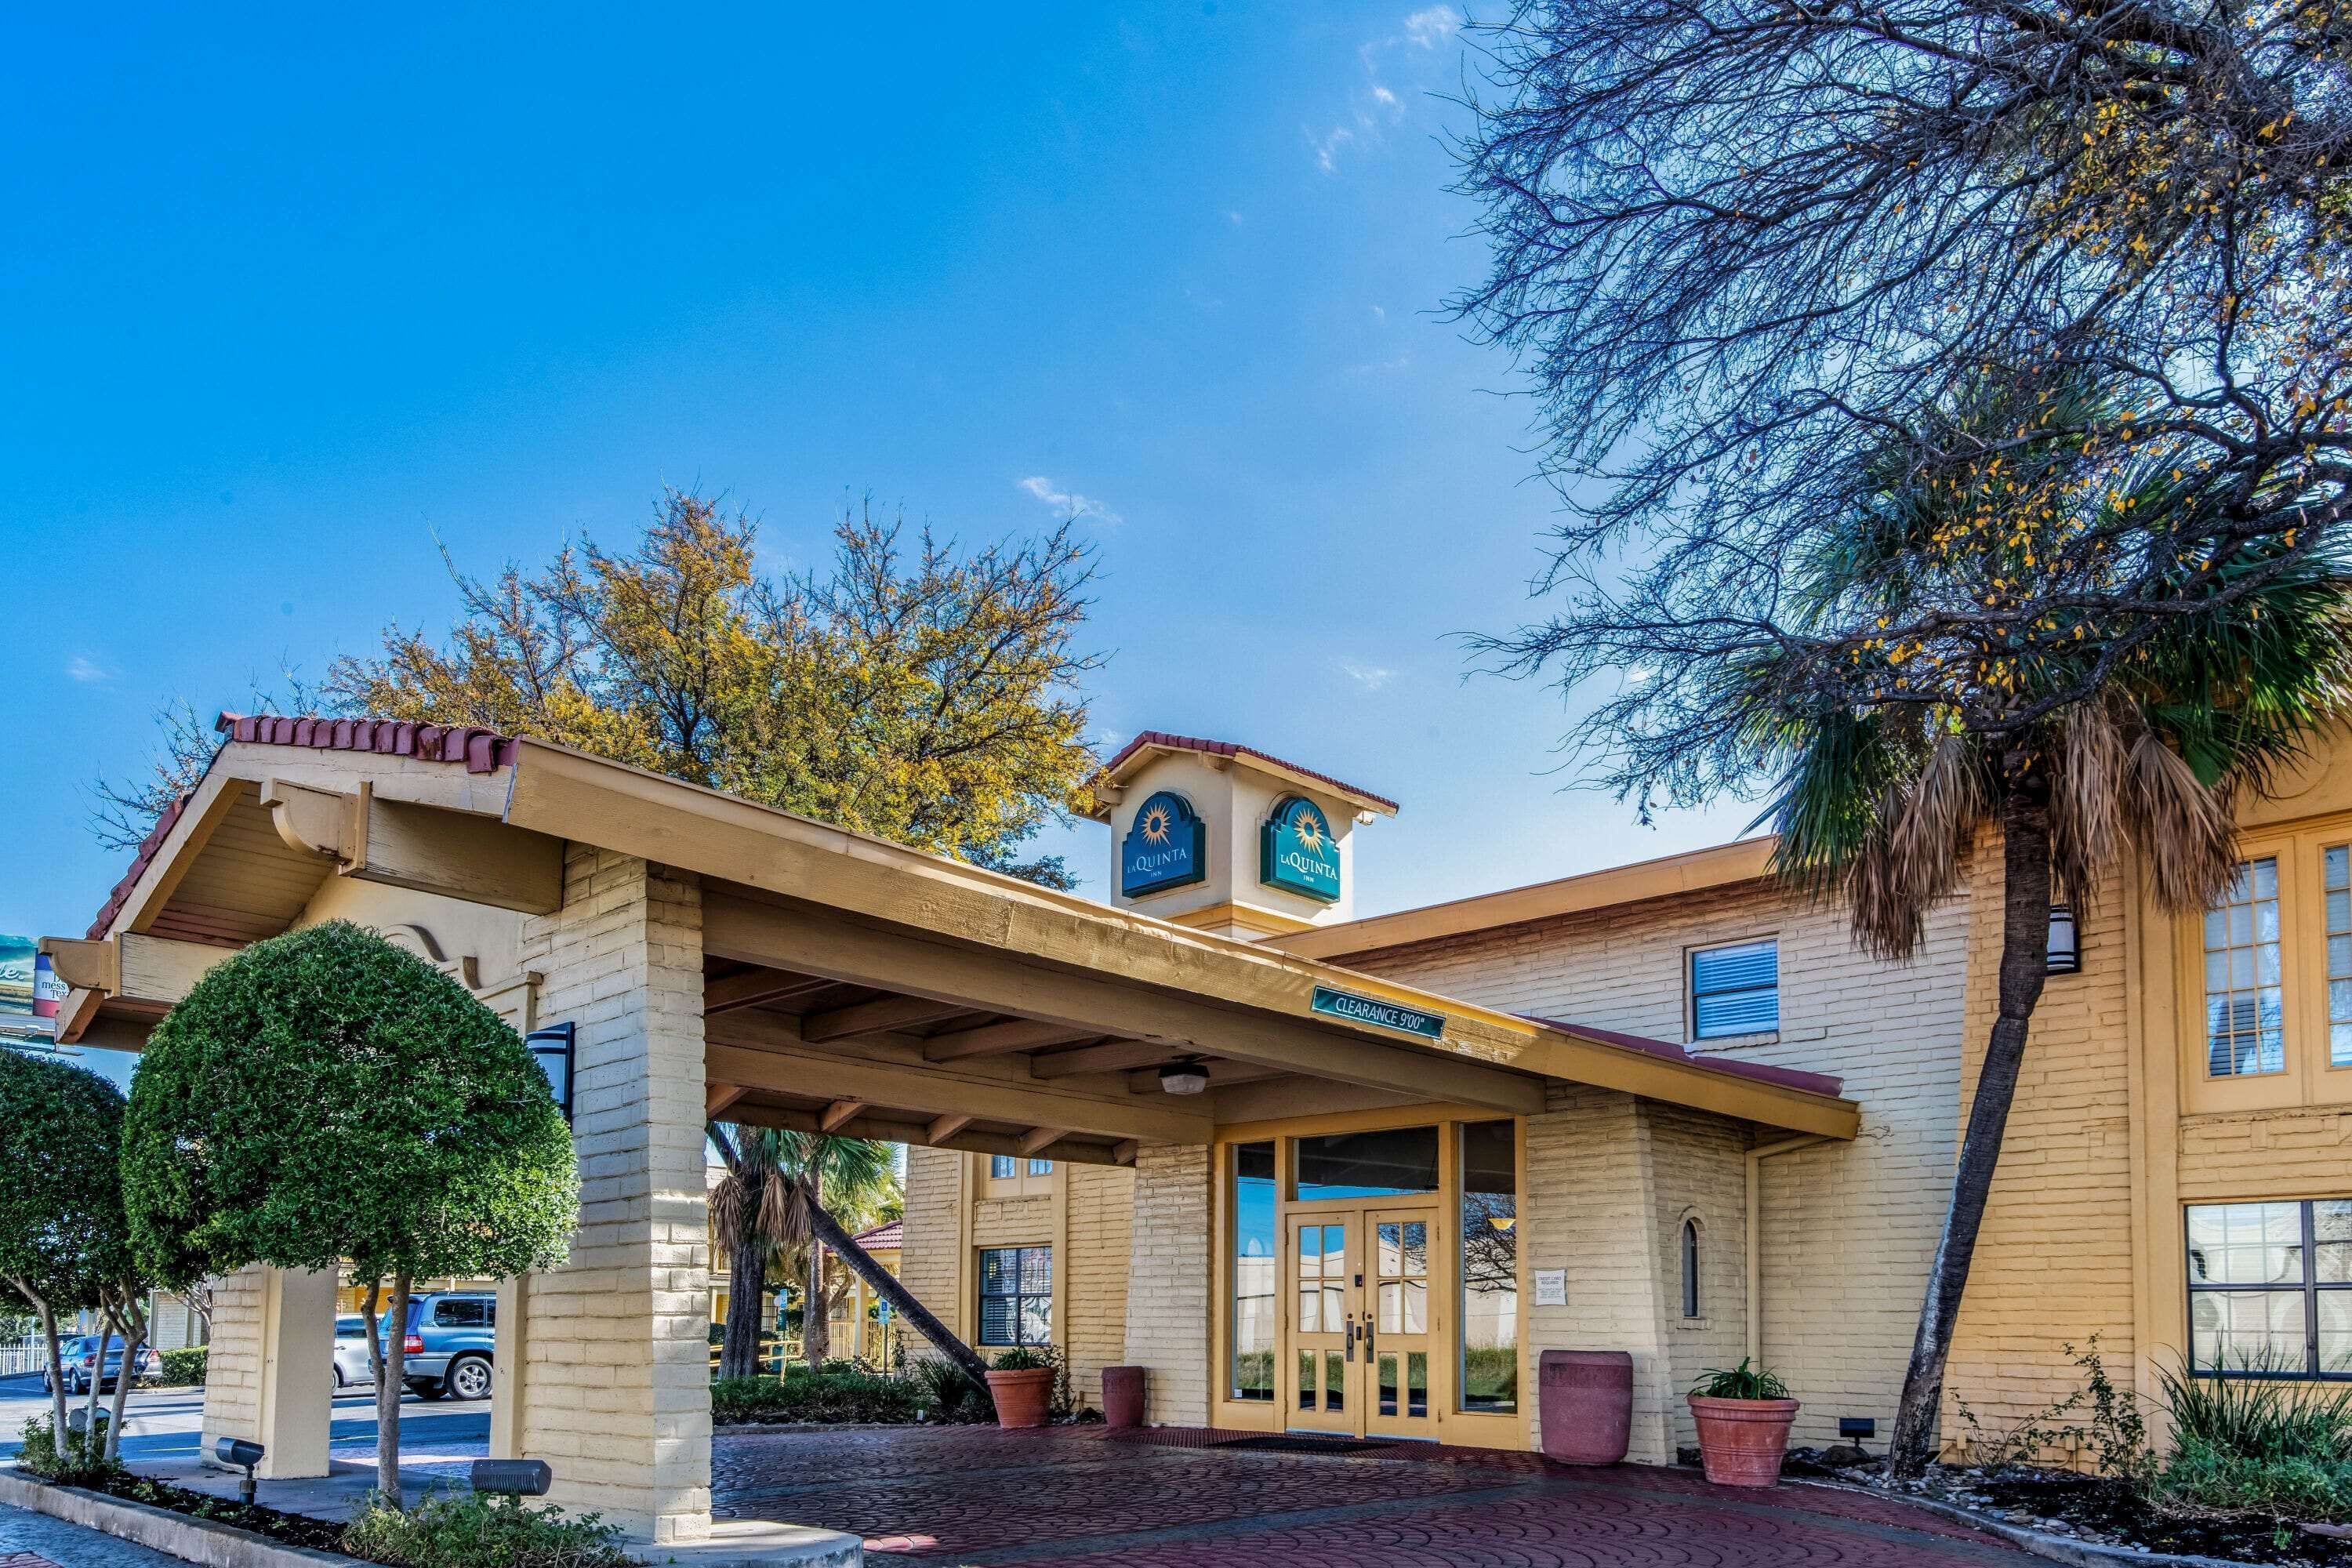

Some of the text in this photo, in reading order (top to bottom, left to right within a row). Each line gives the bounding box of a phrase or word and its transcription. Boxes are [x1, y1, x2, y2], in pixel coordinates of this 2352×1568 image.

[1136, 847, 1187, 872] QUINTA
[1280, 852, 1338, 880] LA QUINTA
[1303, 874, 1314, 883] INN
[42, 982, 66, 990] mess
[1335, 997, 1425, 1029] CLEARANCE 9'00"
